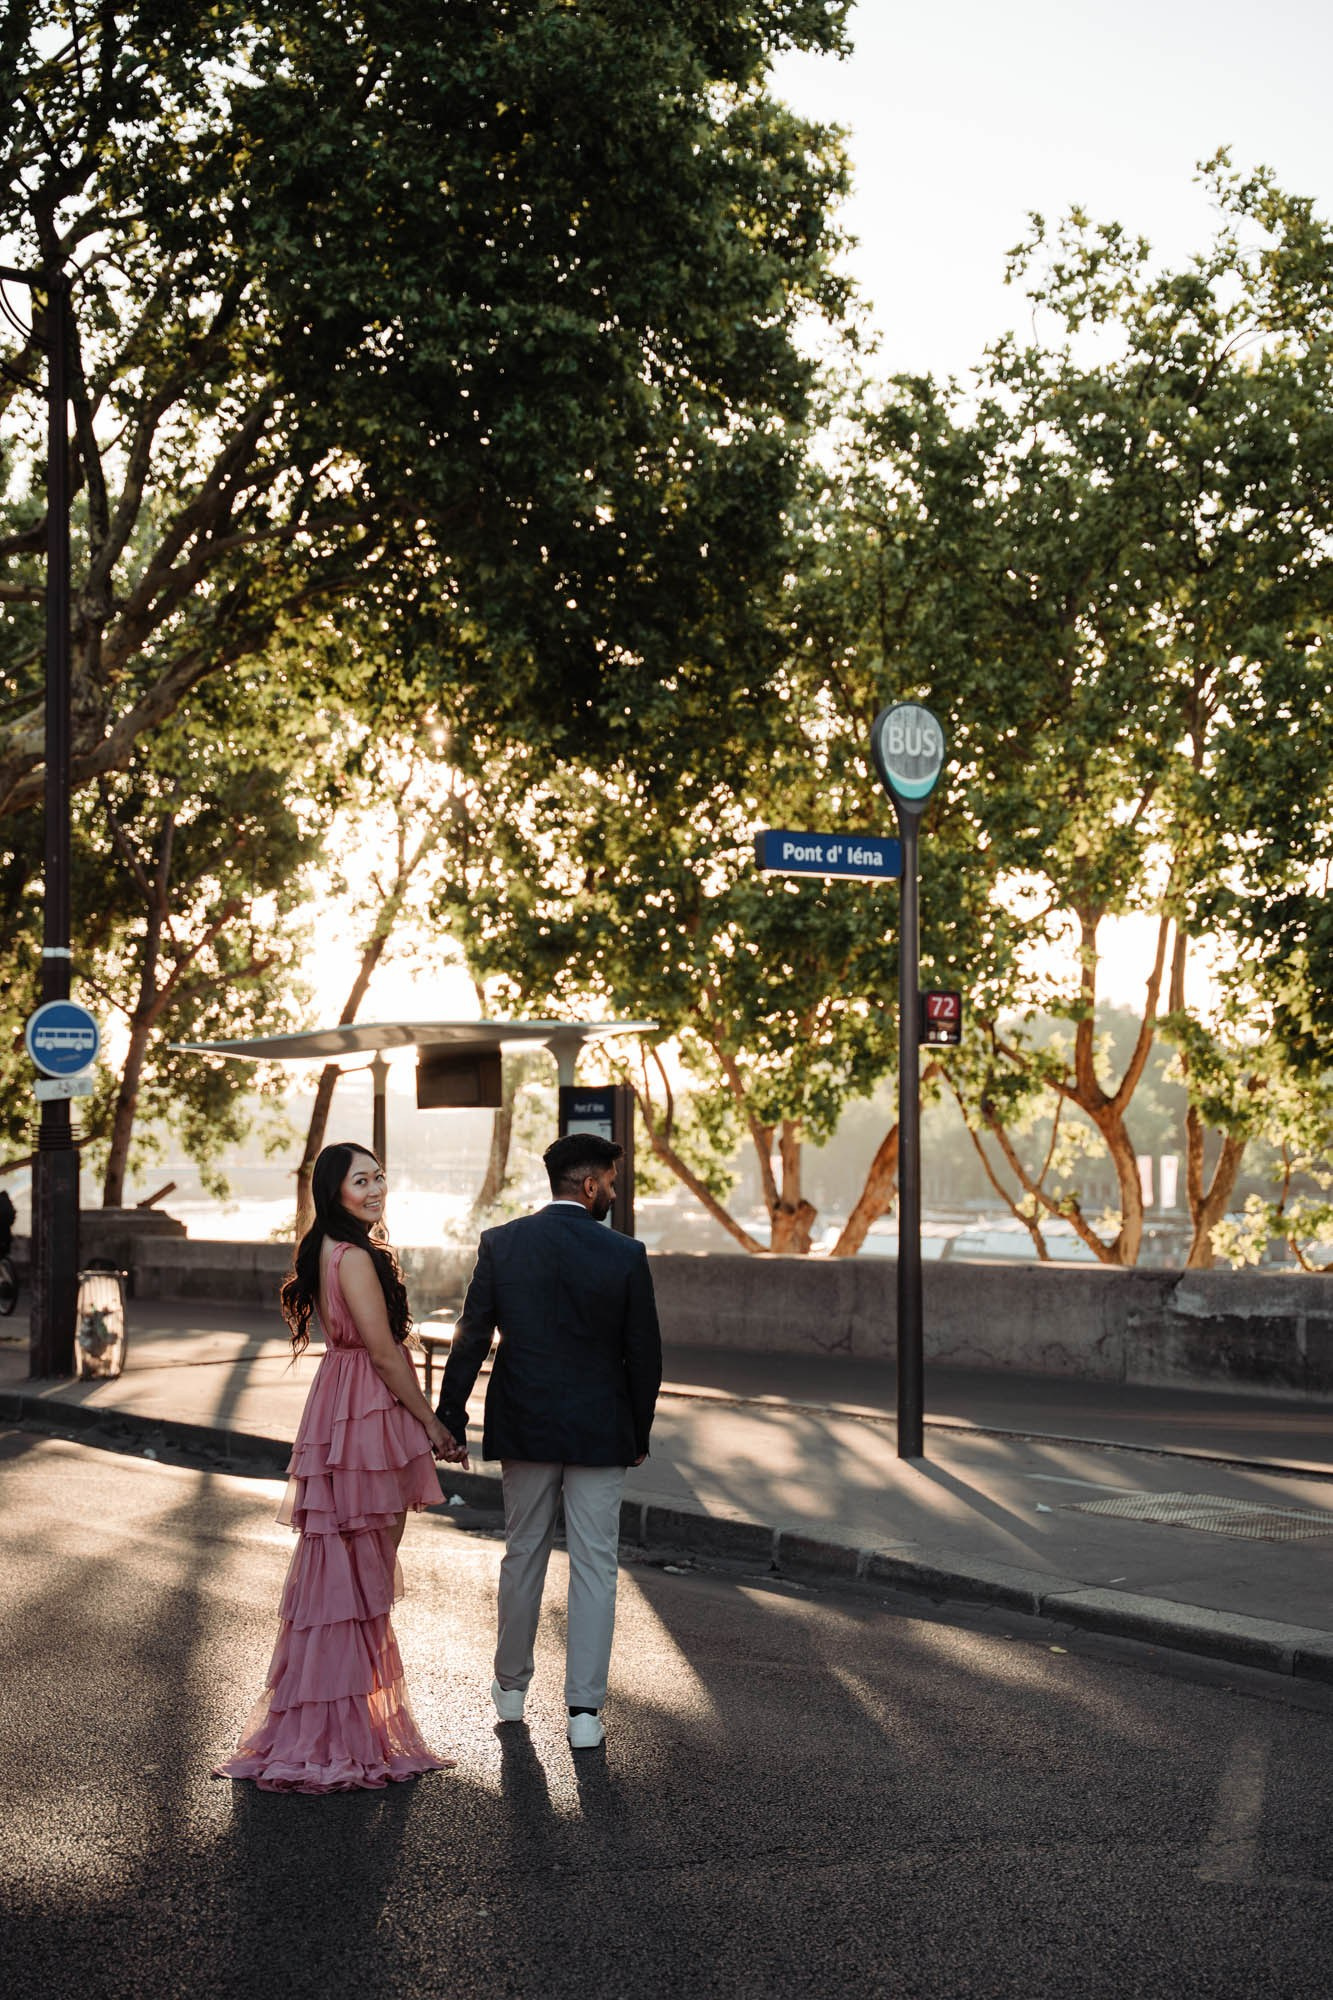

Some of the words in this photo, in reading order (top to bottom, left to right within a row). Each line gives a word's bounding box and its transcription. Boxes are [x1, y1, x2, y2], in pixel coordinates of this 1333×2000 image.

[889, 726, 936, 757] BUS
[782, 842, 823, 863] Pont
[826, 845, 843, 863] d'
[847, 846, 883, 866] Iéna
[931, 996, 955, 1017] 72
